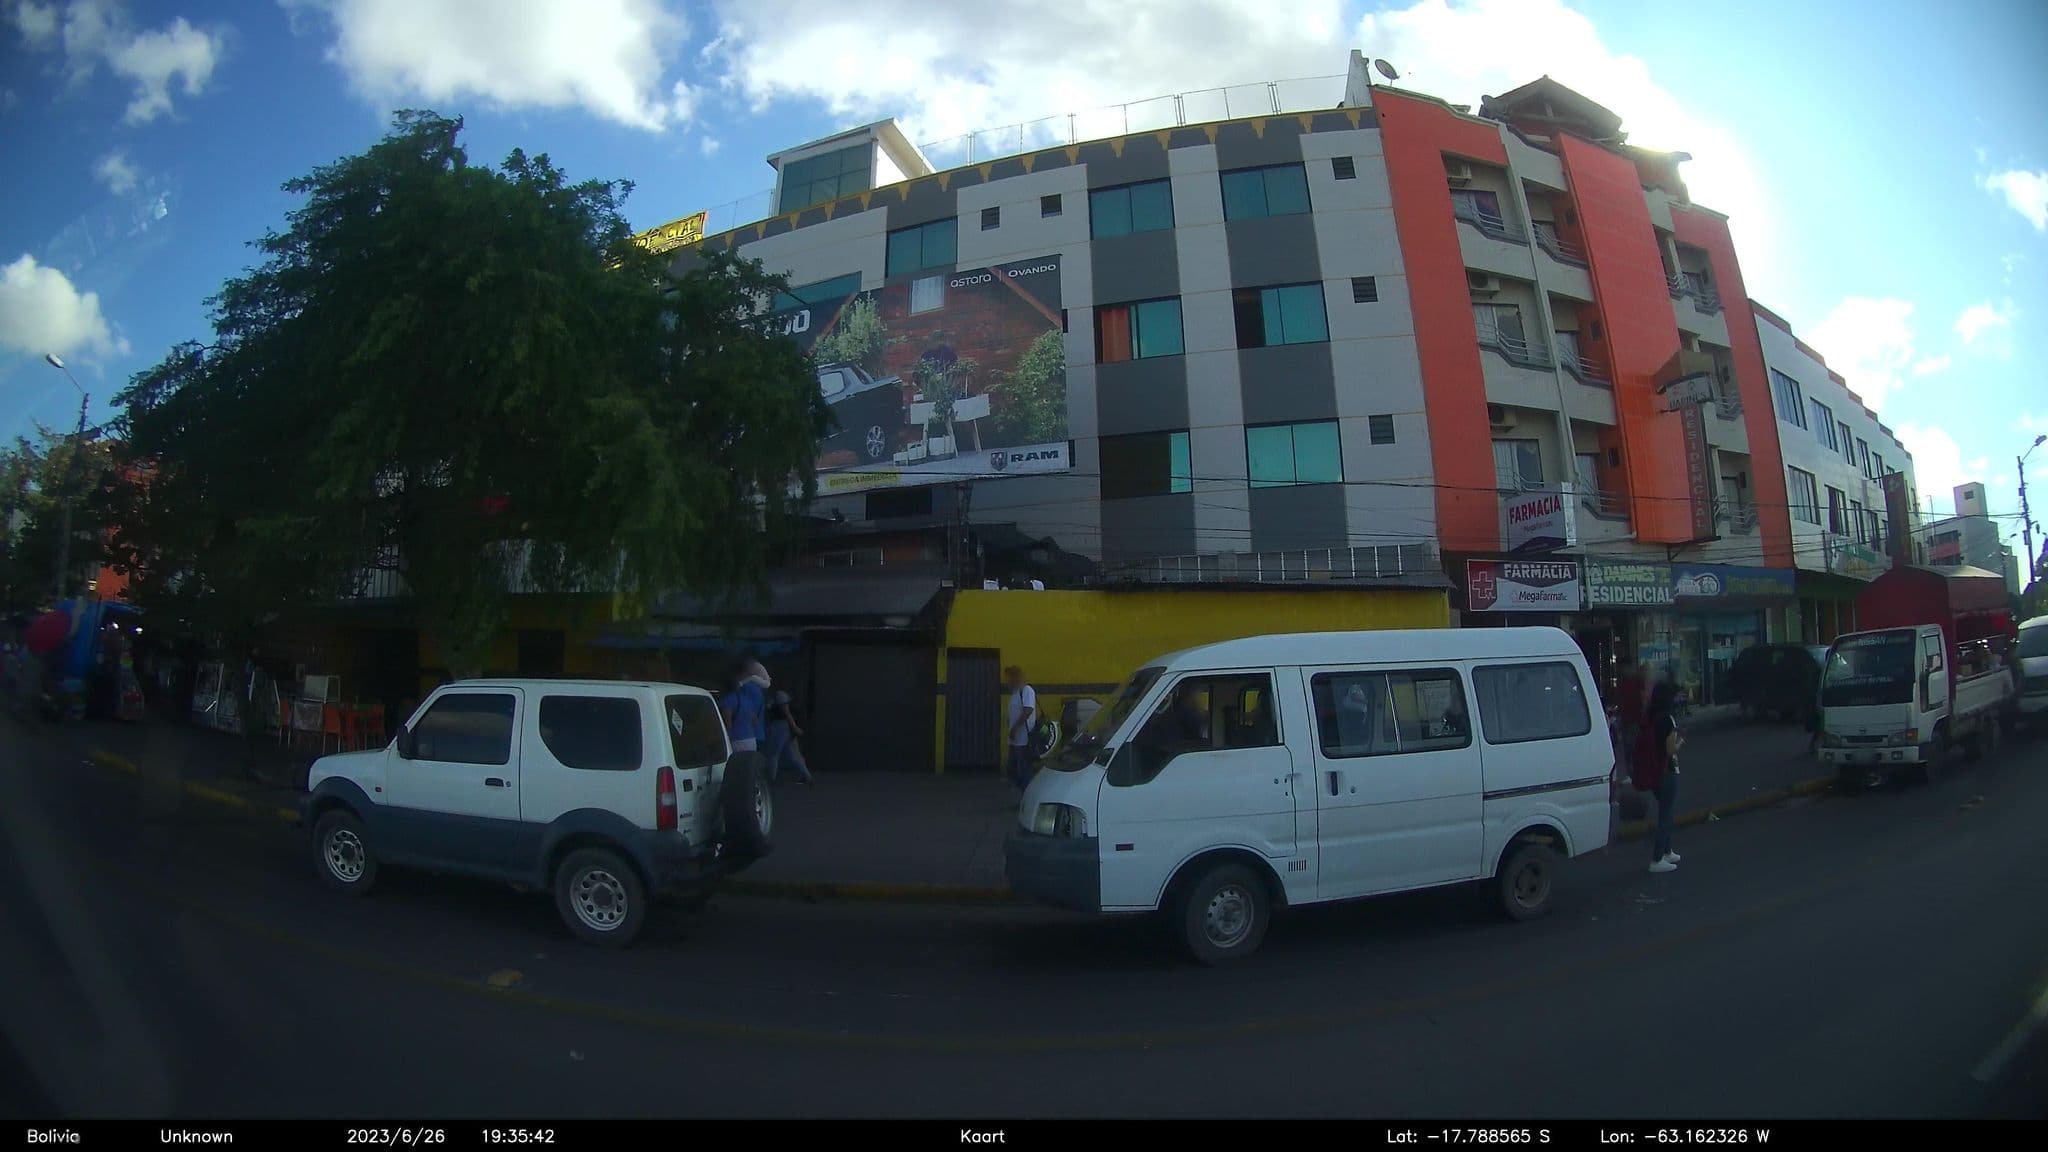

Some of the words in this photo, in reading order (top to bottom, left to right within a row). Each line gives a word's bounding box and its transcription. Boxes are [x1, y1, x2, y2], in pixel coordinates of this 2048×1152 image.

[1011, 450, 1059, 463] RAM
[1509, 494, 1562, 525] FARMACIA
[1503, 563, 1572, 579] FARMACIA
